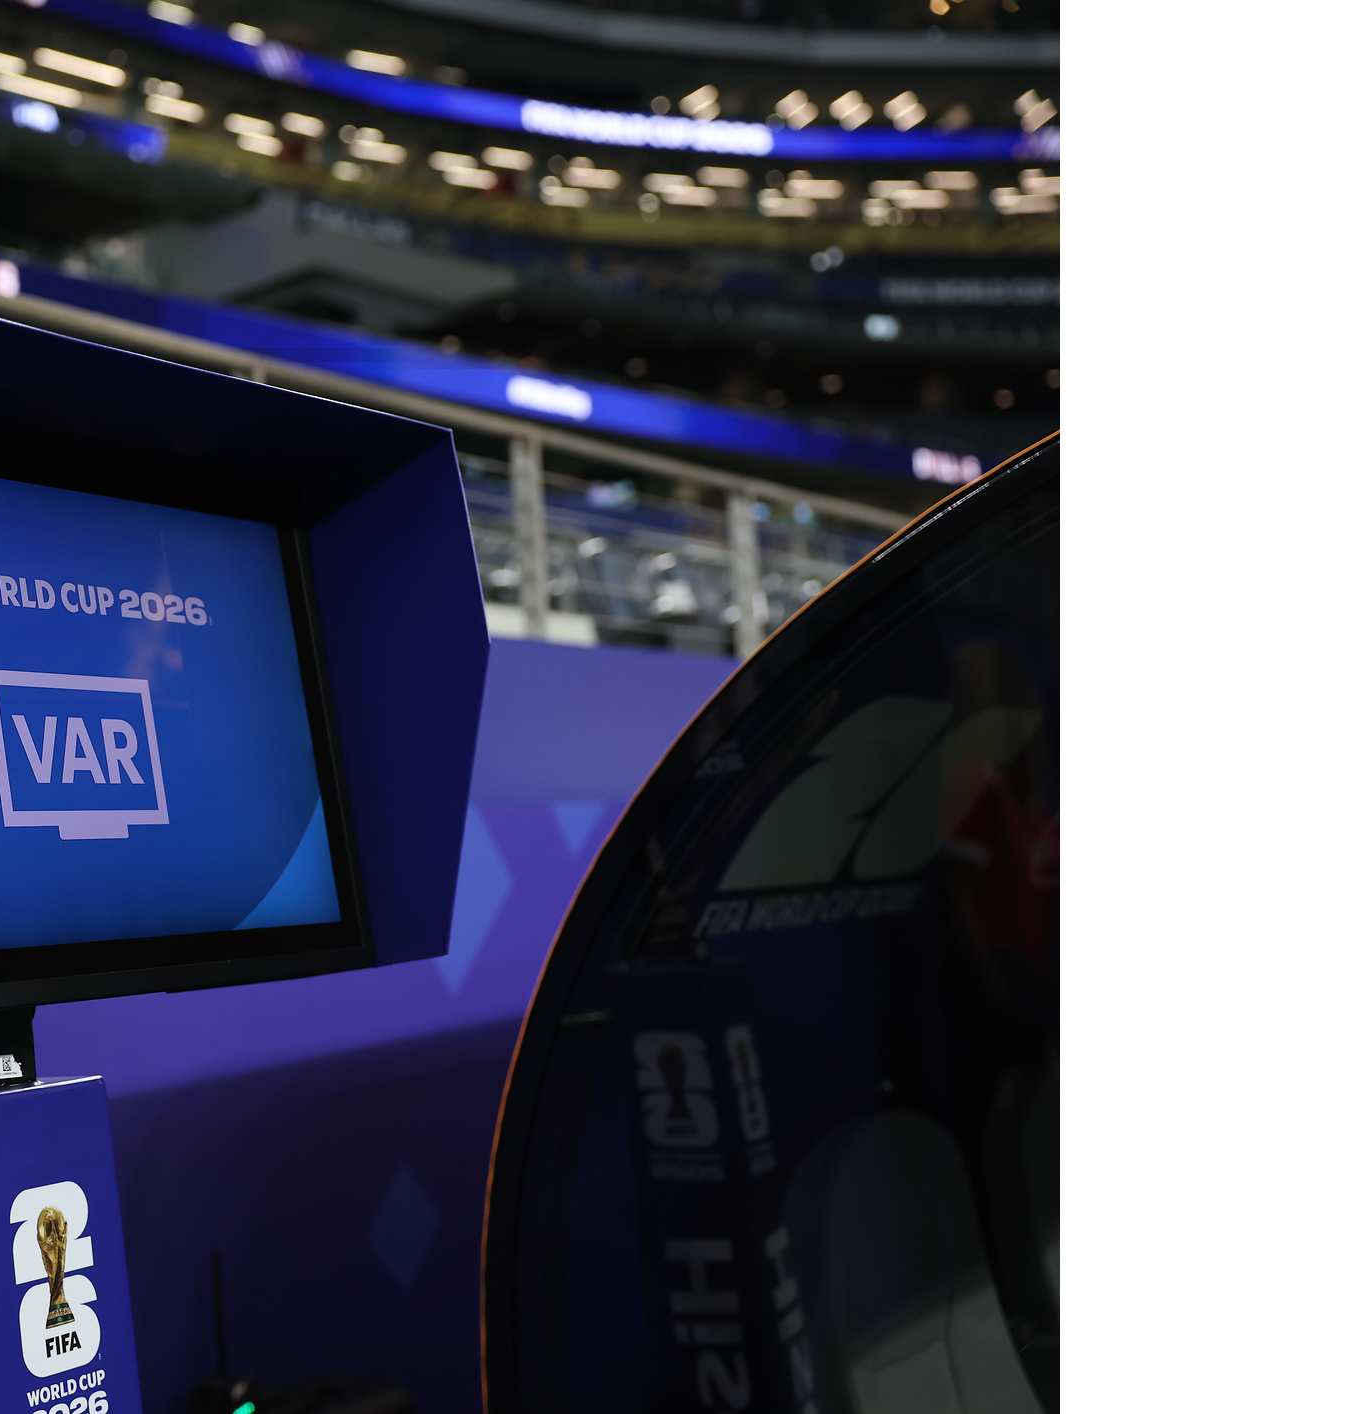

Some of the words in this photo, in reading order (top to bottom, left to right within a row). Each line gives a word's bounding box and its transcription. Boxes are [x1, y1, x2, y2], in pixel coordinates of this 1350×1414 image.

[60, 582, 115, 615] CUP
[118, 589, 208, 626] 2026
[11, 714, 145, 785] VAR
[45, 1331, 82, 1358] FIFA
[26, 1379, 78, 1408] WORLD
[78, 1369, 106, 1392] CUP
[32, 1390, 109, 1414] 26
